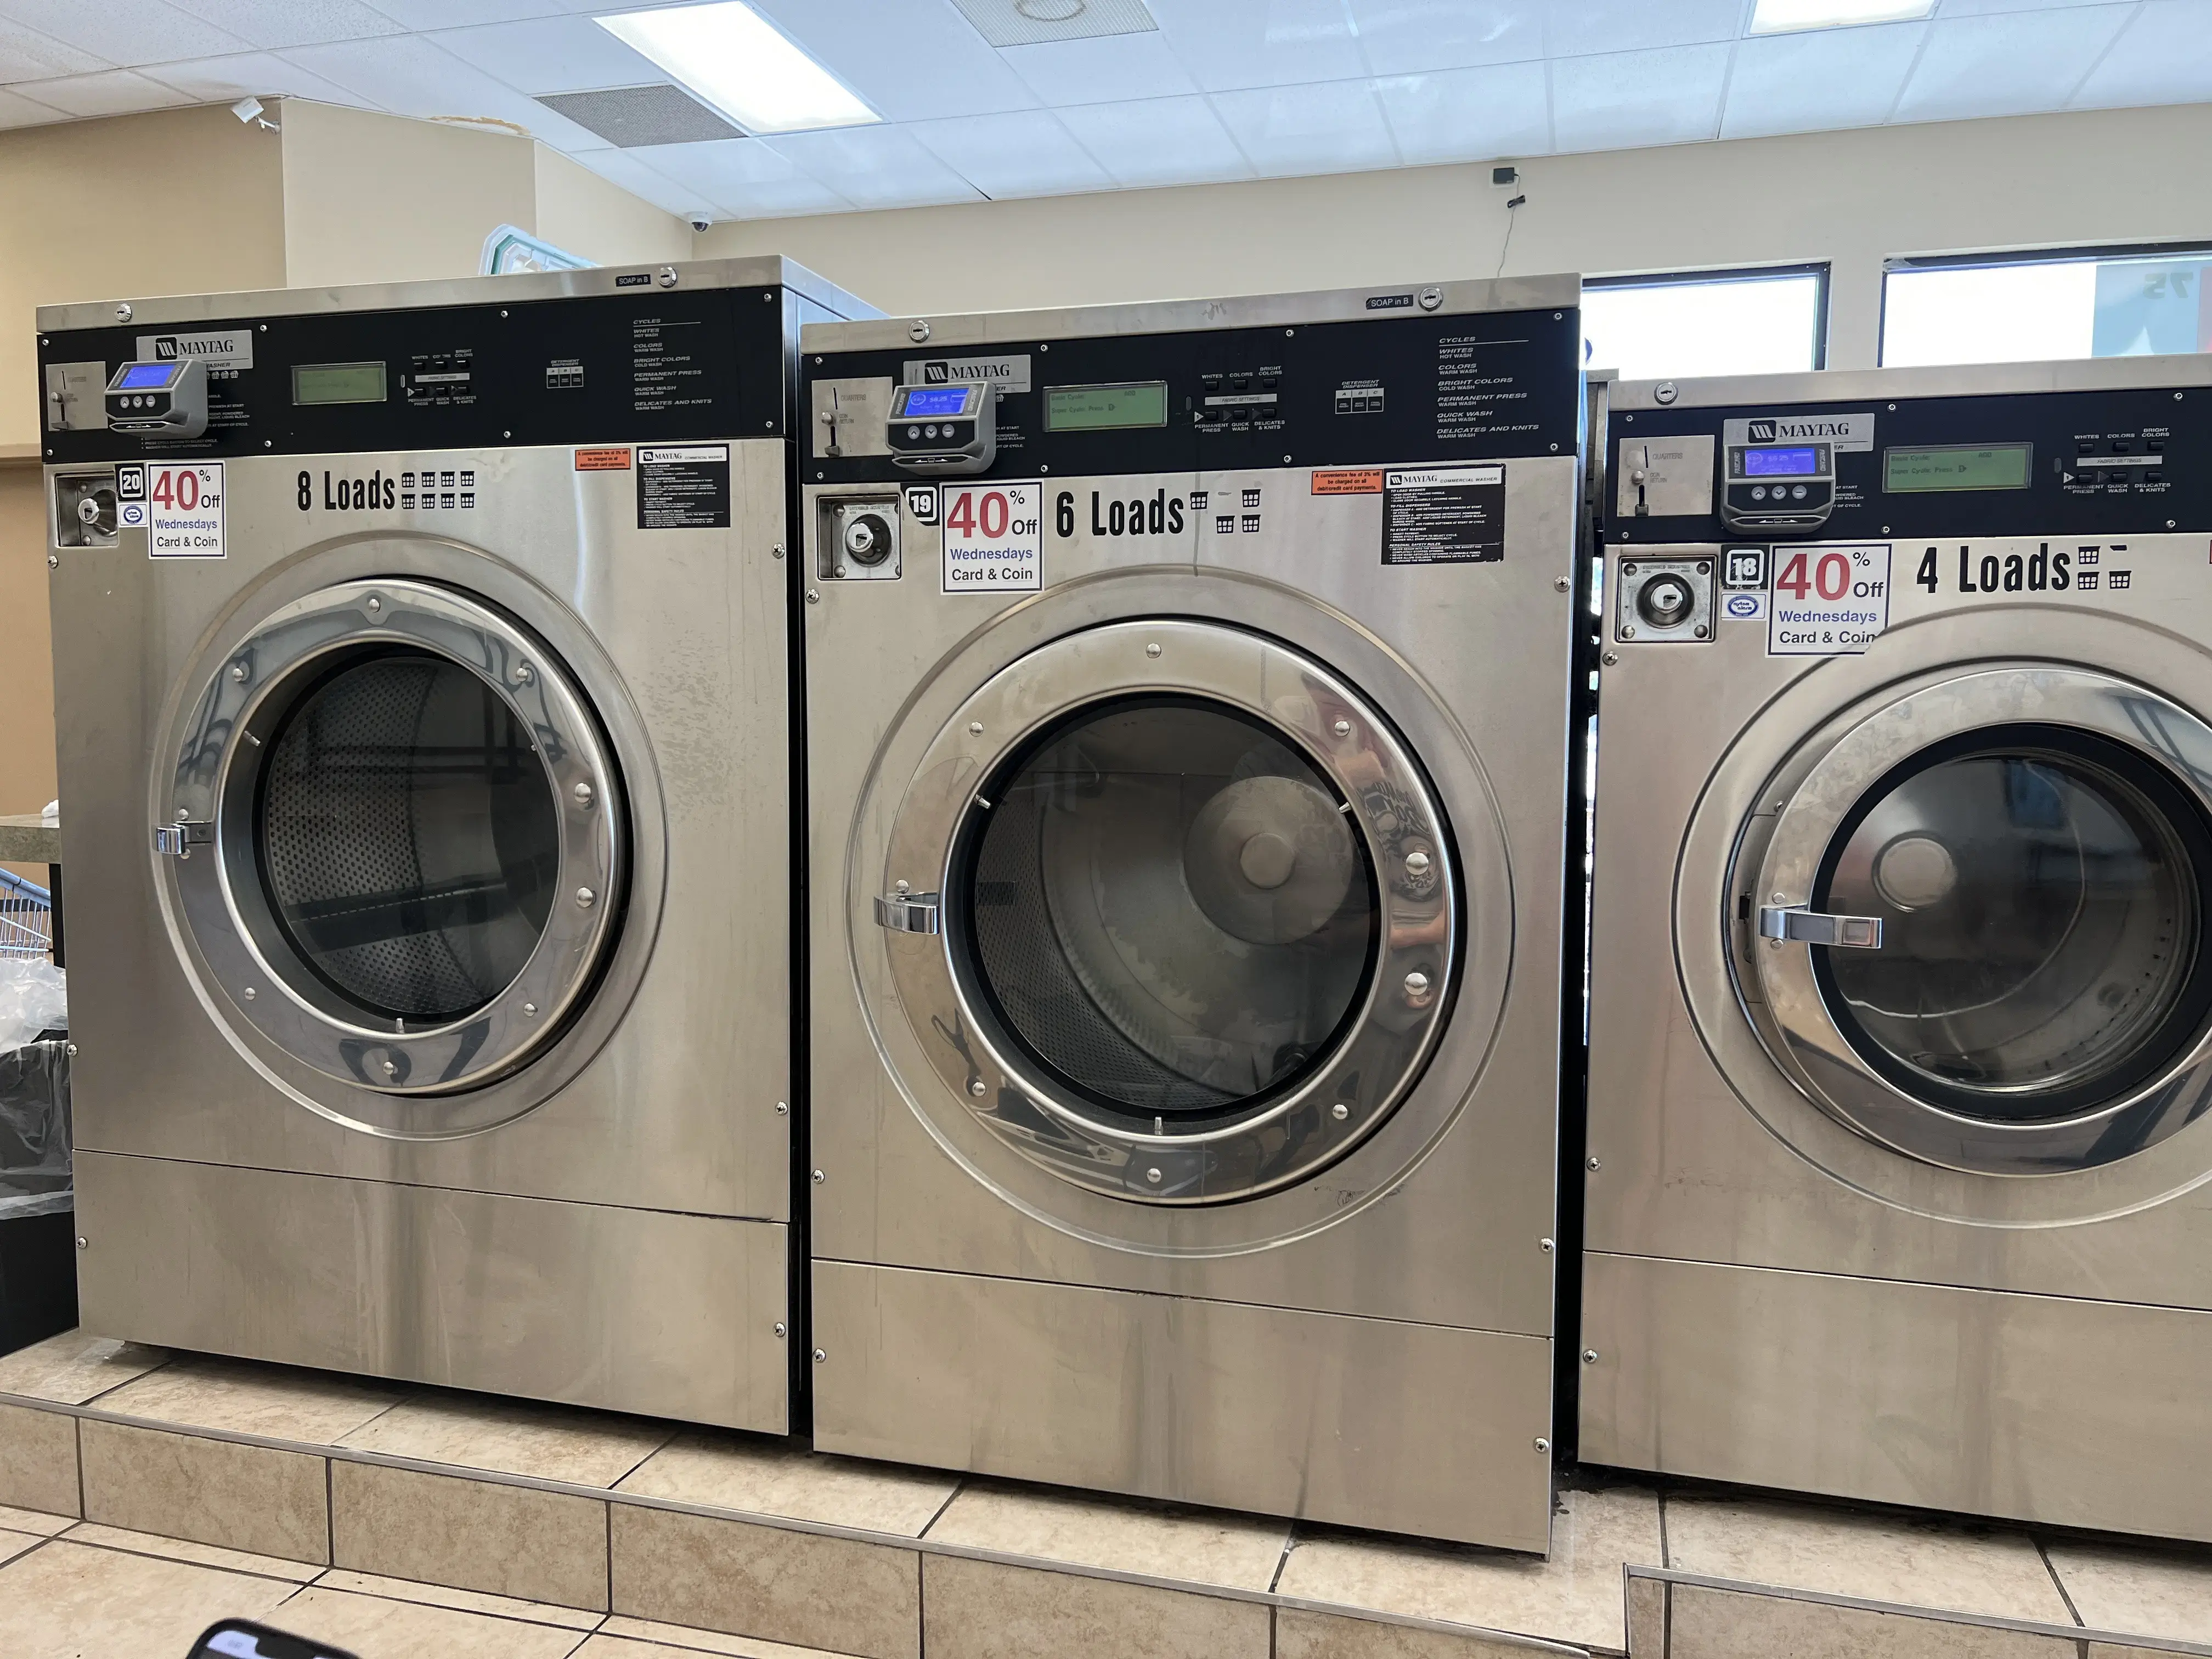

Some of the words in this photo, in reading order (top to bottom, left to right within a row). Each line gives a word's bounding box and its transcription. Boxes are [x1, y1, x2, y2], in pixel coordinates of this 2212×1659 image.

[1372, 298, 1393, 307] SOAP
[179, 340, 233, 355] MAYTAG
[951, 364, 1009, 379] MAYTAG
[1780, 422, 1849, 437] MAYTAG
[123, 475, 140, 490] 20
[153, 471, 198, 510] 40
[200, 470, 211, 482] %
[298, 471, 311, 511] 8
[325, 470, 395, 510] Loads
[201, 495, 220, 507] Off
[911, 495, 931, 513] 19
[947, 492, 1008, 538] 40
[1010, 490, 1025, 505] %
[1057, 492, 1074, 537] 6
[1092, 488, 1183, 536] Loads
[156, 519, 217, 531] Wednesdays
[1012, 520, 1037, 535] Off
[157, 537, 180, 546] Card
[184, 537, 190, 546] &
[195, 537, 217, 546] Coin
[950, 548, 1032, 561] Wednesdays
[952, 568, 983, 580] Card
[988, 568, 997, 579] &
[1002, 568, 1032, 579] Coin
[1733, 557, 1756, 576] 18
[1917, 547, 1938, 593] 4
[1960, 543, 2070, 592] Loads
[1777, 553, 1850, 600] 40
[1853, 552, 1870, 566] %
[1853, 582, 1883, 597] Off
[1779, 611, 1877, 624] Wednesdays
[1780, 631, 1816, 643] Card
[1822, 631, 1832, 643] &
[1839, 631, 1876, 643] Coin
